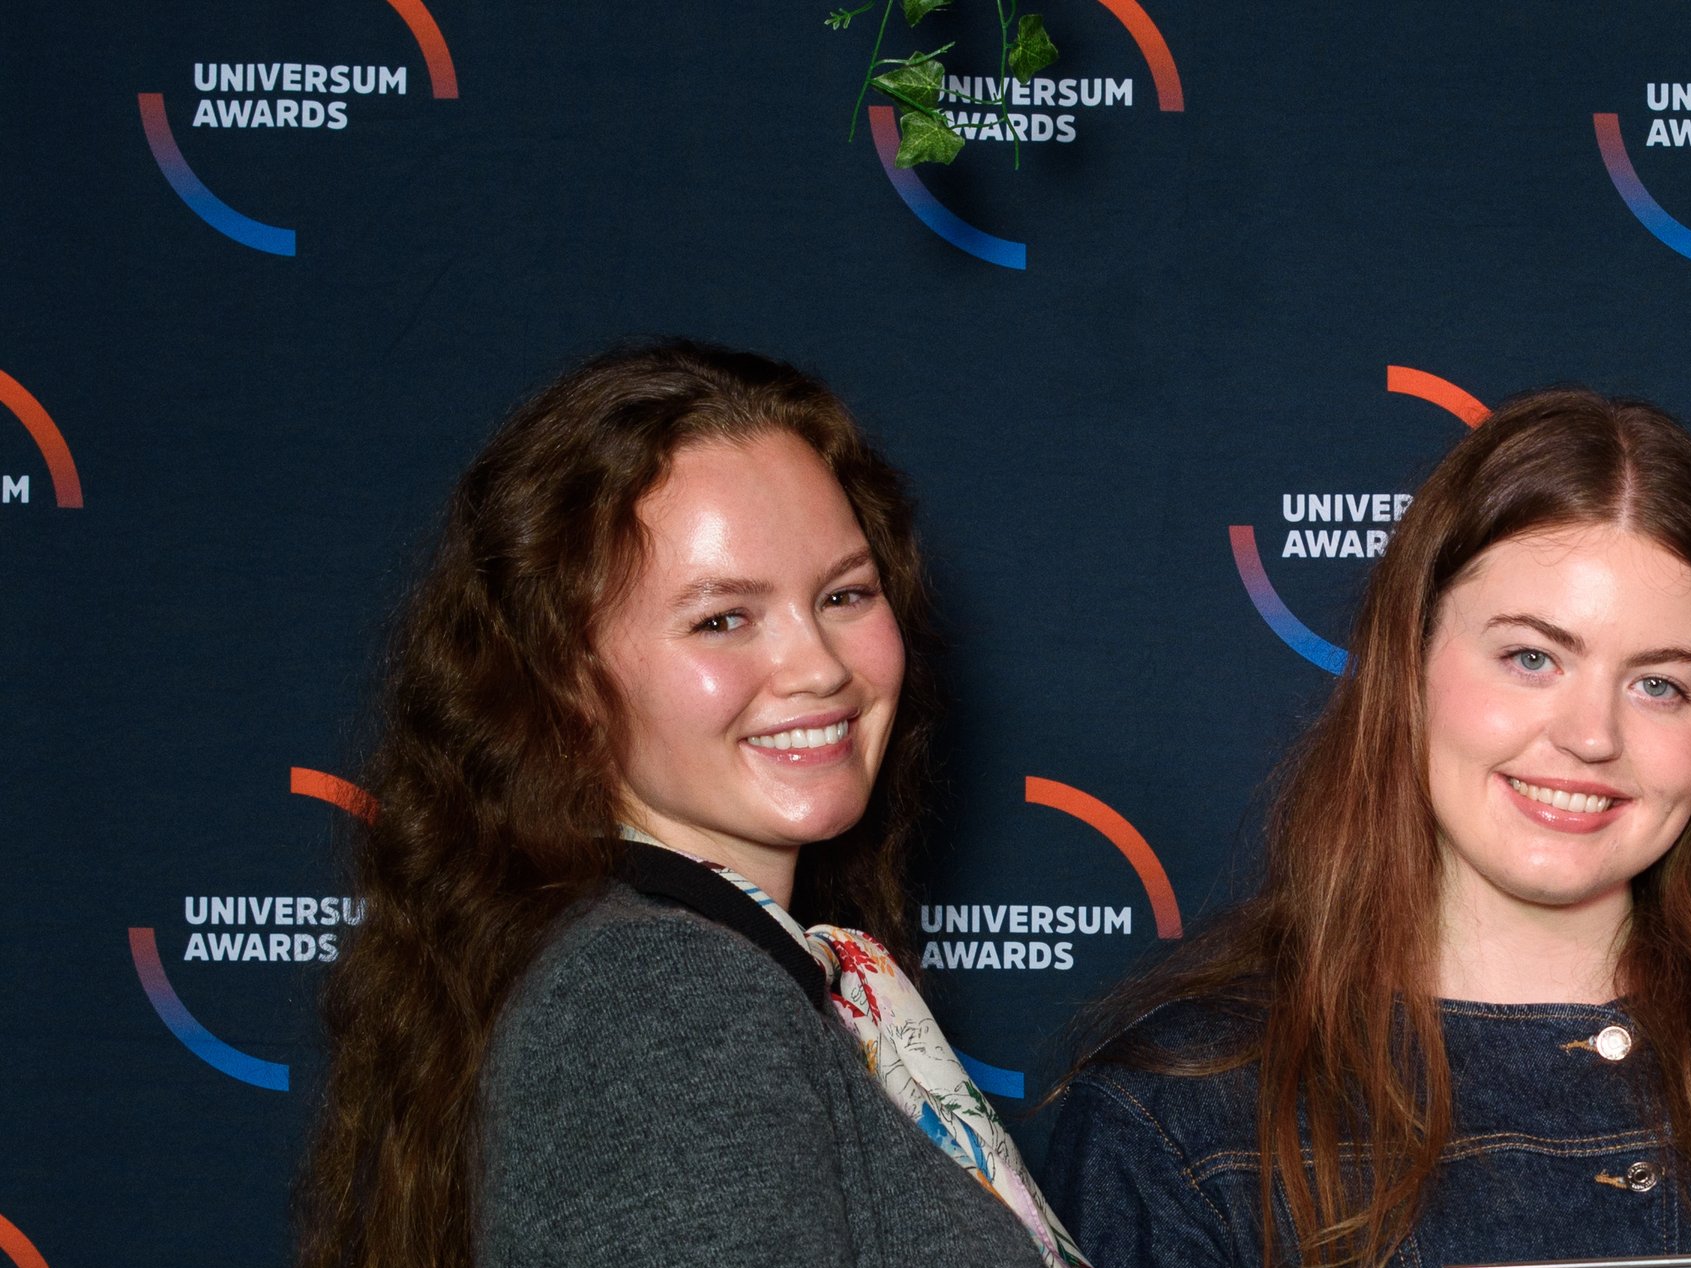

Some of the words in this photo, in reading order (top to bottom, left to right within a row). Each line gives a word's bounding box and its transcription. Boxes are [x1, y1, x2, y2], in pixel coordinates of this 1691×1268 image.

[194, 62, 407, 95] UNIVERSUM
[192, 99, 348, 130] AWARDS
[945, 110, 1077, 143] WARDS
[184, 896, 367, 926] UNIVERSU
[920, 904, 1132, 935] UNIVERSUM
[183, 932, 339, 963] AWARDS
[920, 941, 1074, 971] AWARDS
